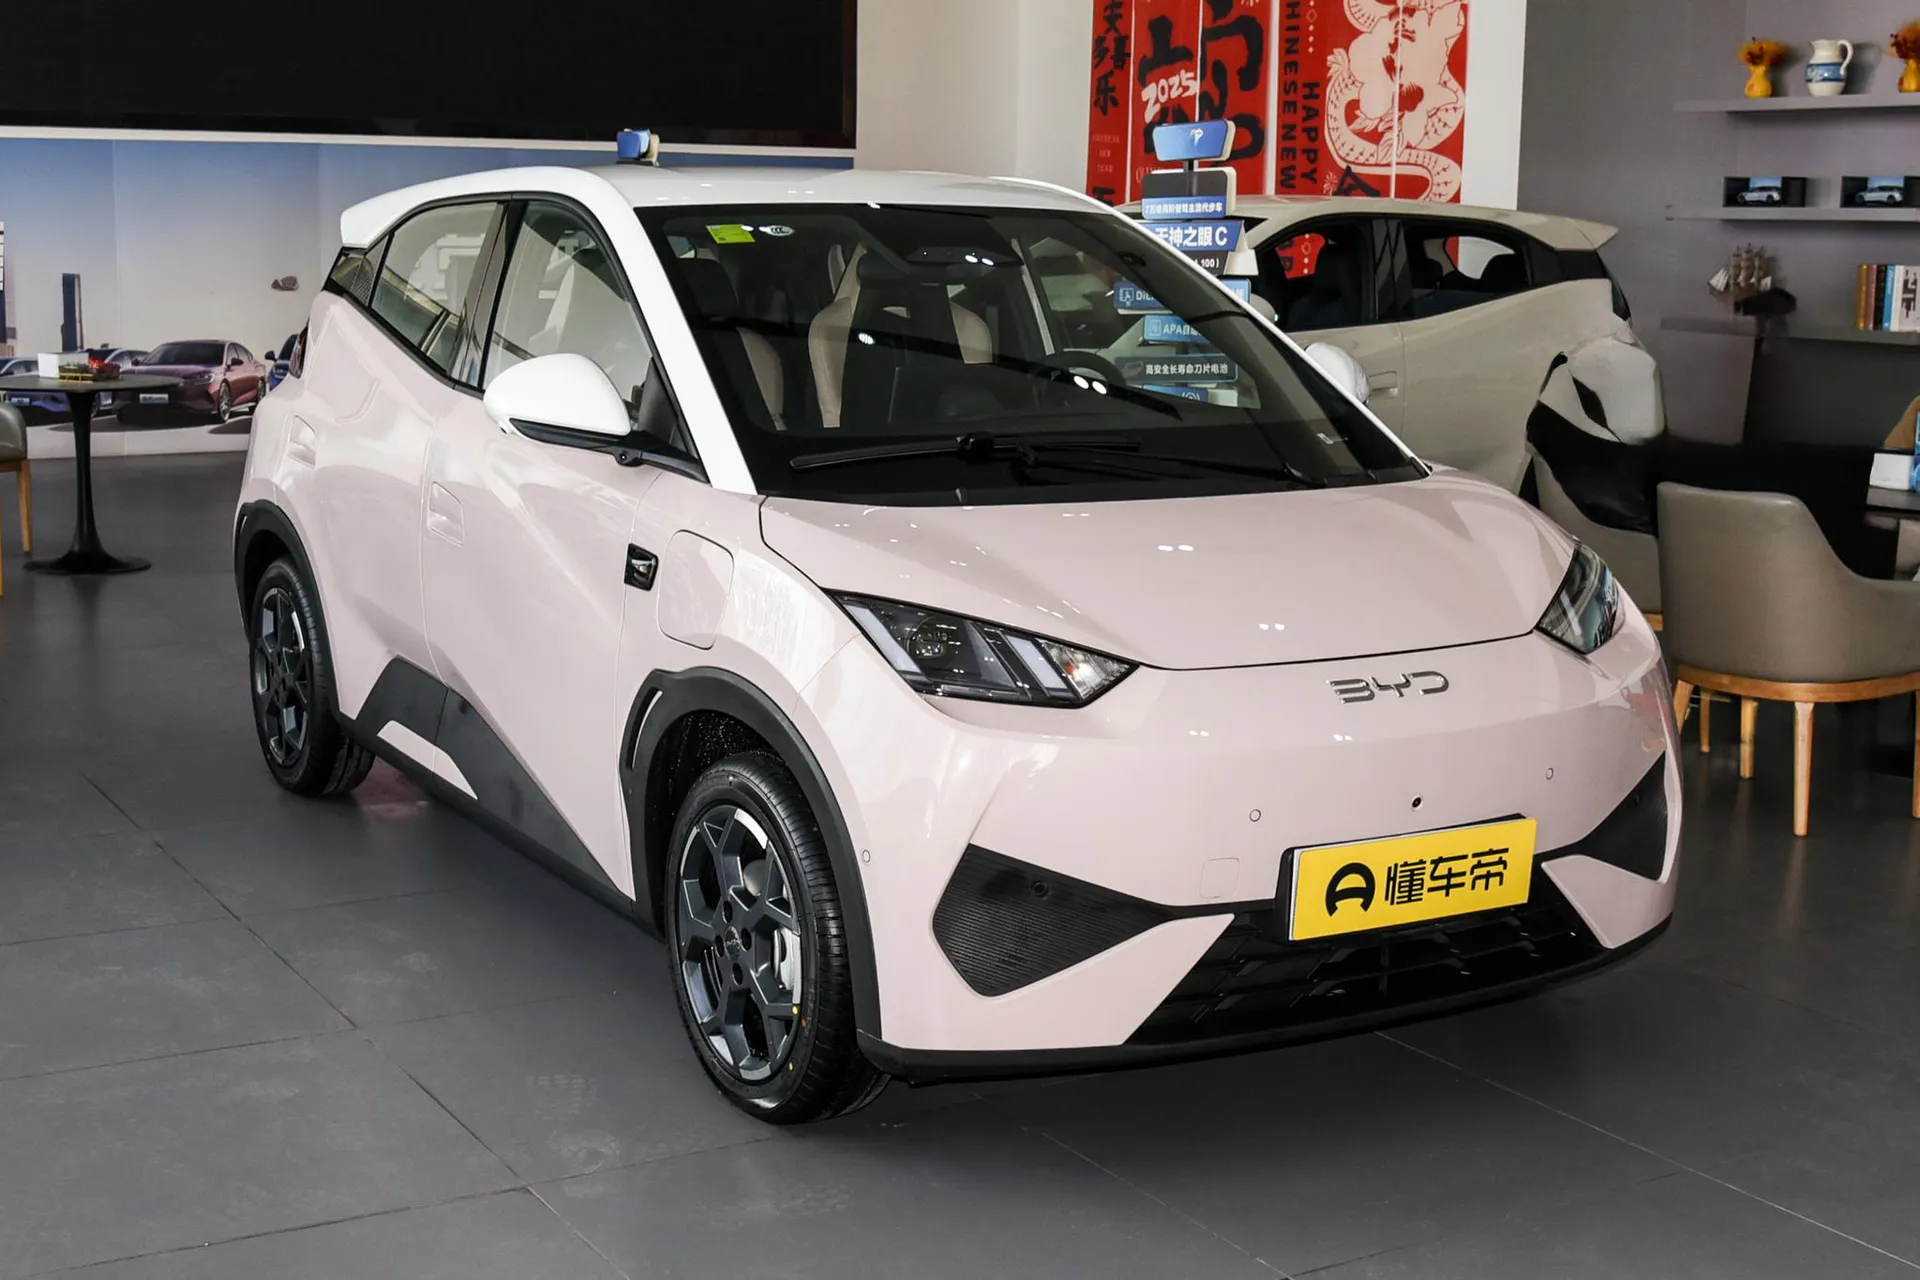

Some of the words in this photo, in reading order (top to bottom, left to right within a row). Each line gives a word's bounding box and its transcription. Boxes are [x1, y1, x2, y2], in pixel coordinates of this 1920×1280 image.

[1141, 70, 1198, 123] 2025
[1280, 124, 1298, 189] NEW
[1302, 82, 1321, 184] HAPPY
[1136, 290, 1154, 301] DiL
[1145, 363, 1229, 375] 高安全长寿命刀片电池
[1326, 670, 1449, 704] BYD
[1385, 847, 1509, 906] 懂车帝
